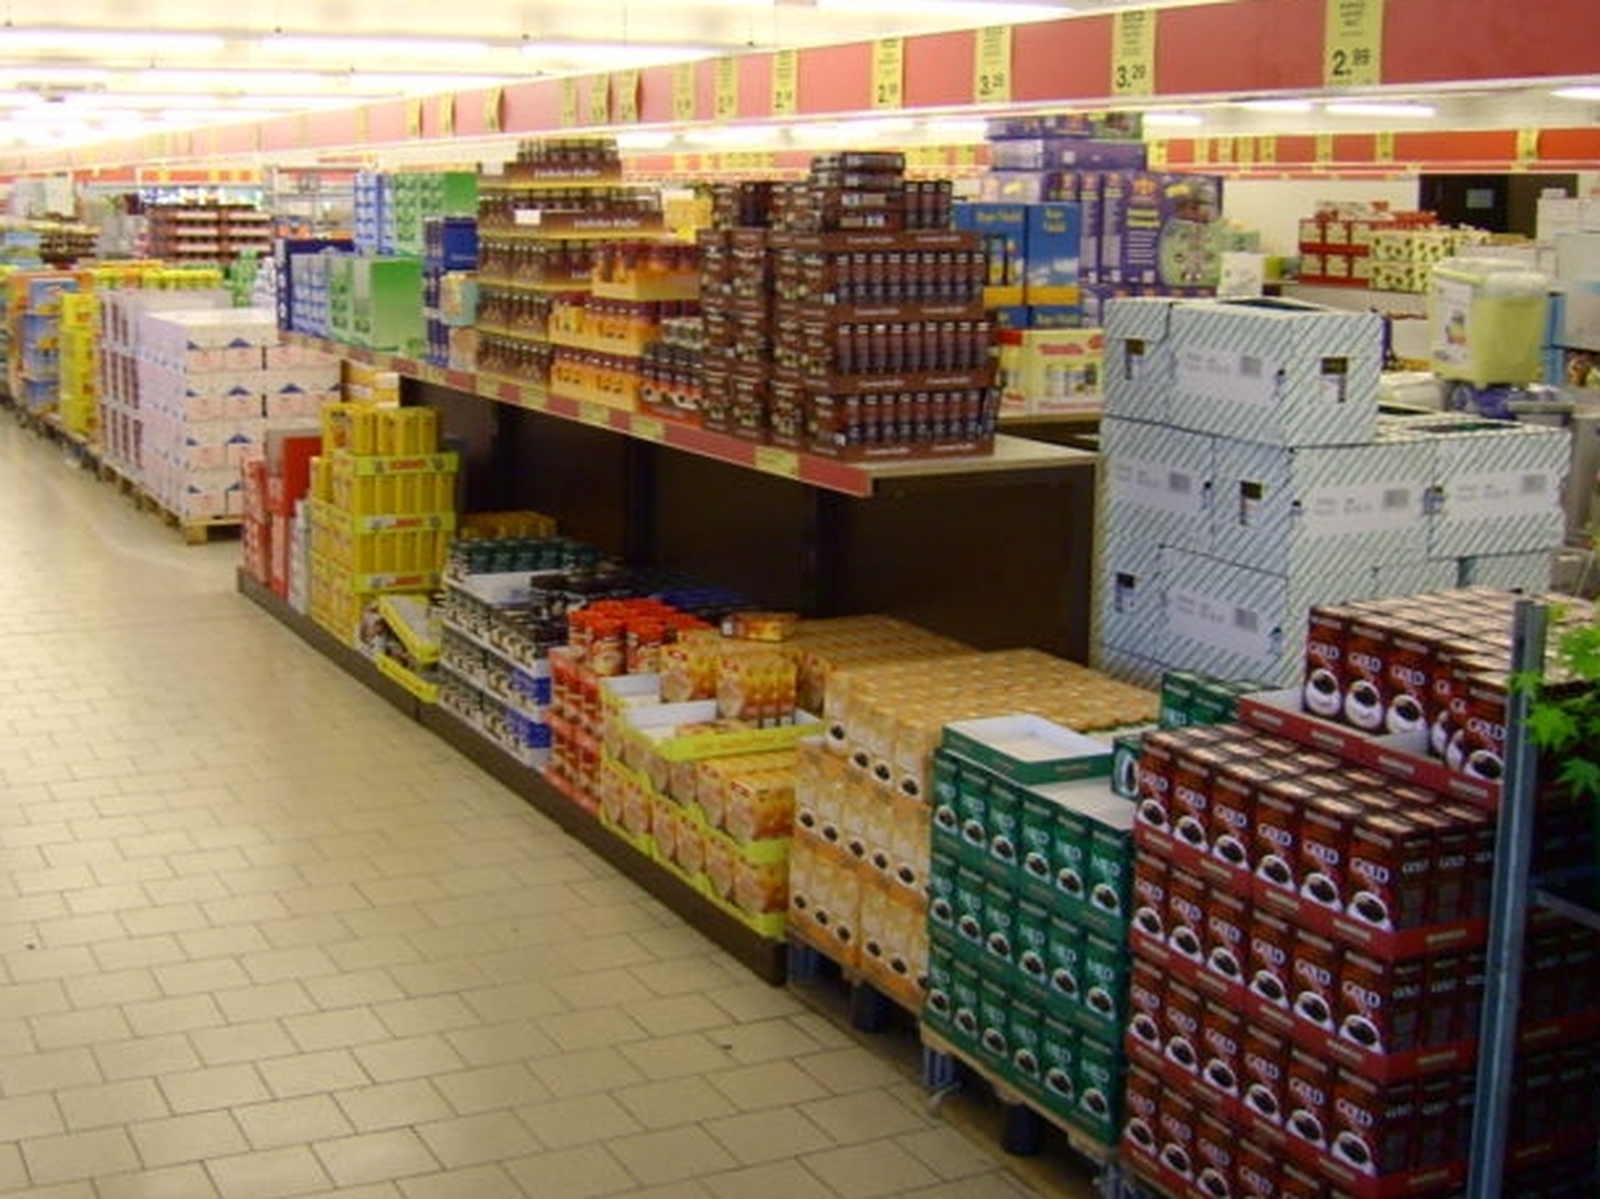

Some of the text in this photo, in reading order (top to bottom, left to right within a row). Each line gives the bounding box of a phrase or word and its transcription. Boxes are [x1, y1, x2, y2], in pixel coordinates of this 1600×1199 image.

[1303, 841, 1339, 865] GOLD
[1350, 857, 1390, 884] GOLD
[1295, 959, 1331, 985] GOLD
[1342, 981, 1381, 1008] GOLD
